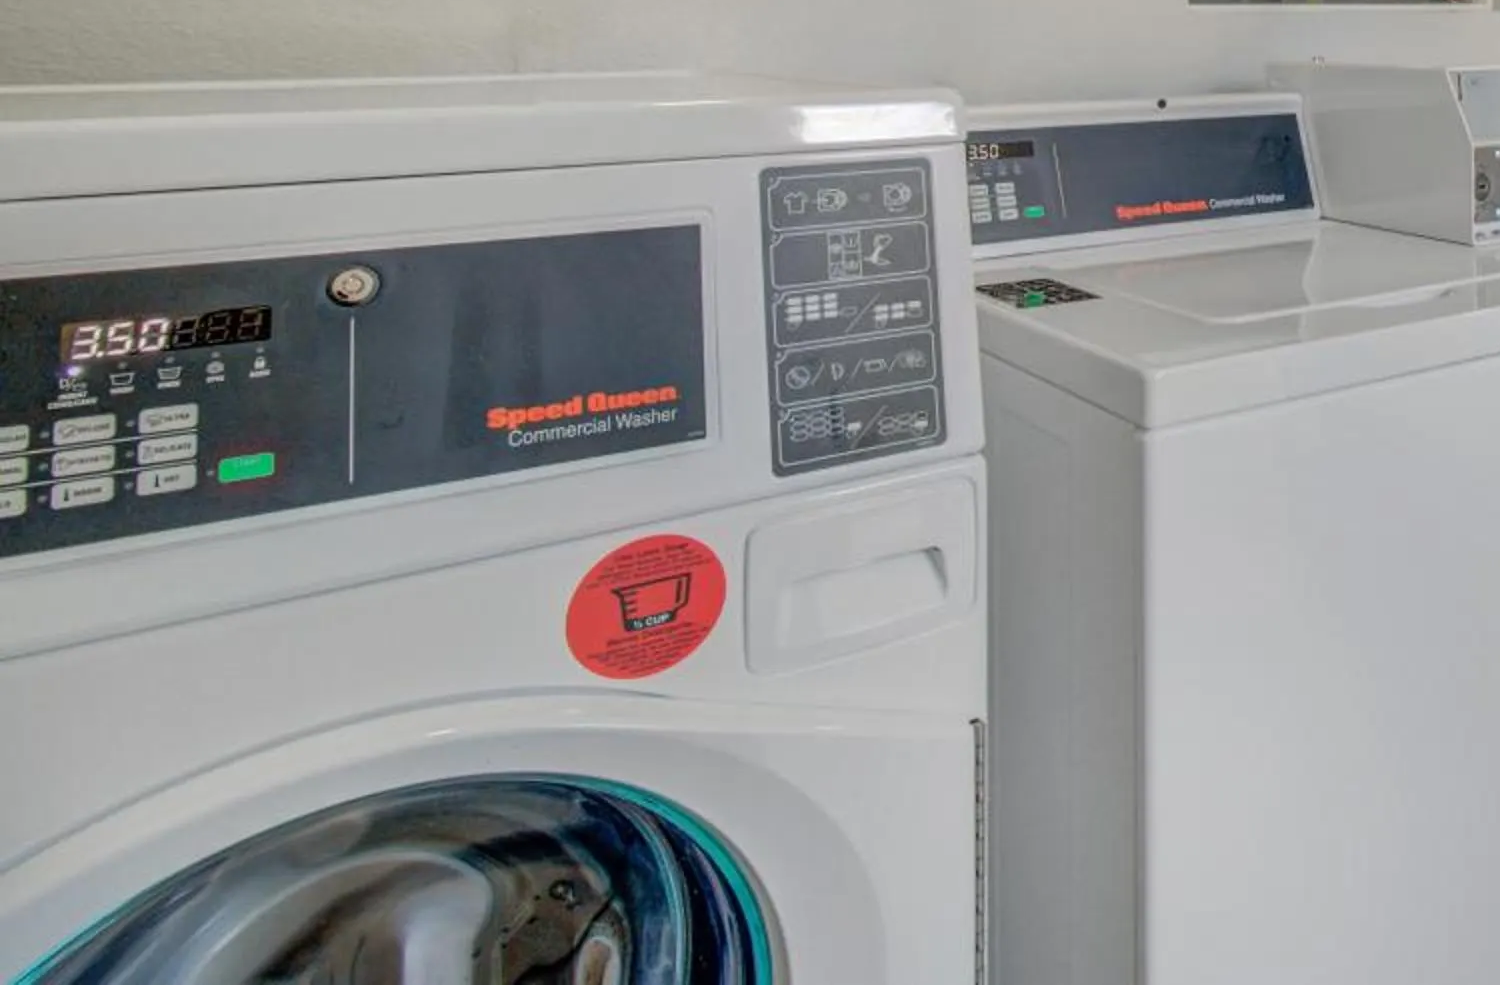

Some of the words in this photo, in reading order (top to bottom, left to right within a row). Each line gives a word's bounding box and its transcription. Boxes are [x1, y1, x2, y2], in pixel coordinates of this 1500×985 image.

[486, 396, 583, 430] Speed
[587, 386, 677, 412] Queen
[508, 418, 611, 448] Commercial
[615, 407, 679, 431] Washer
